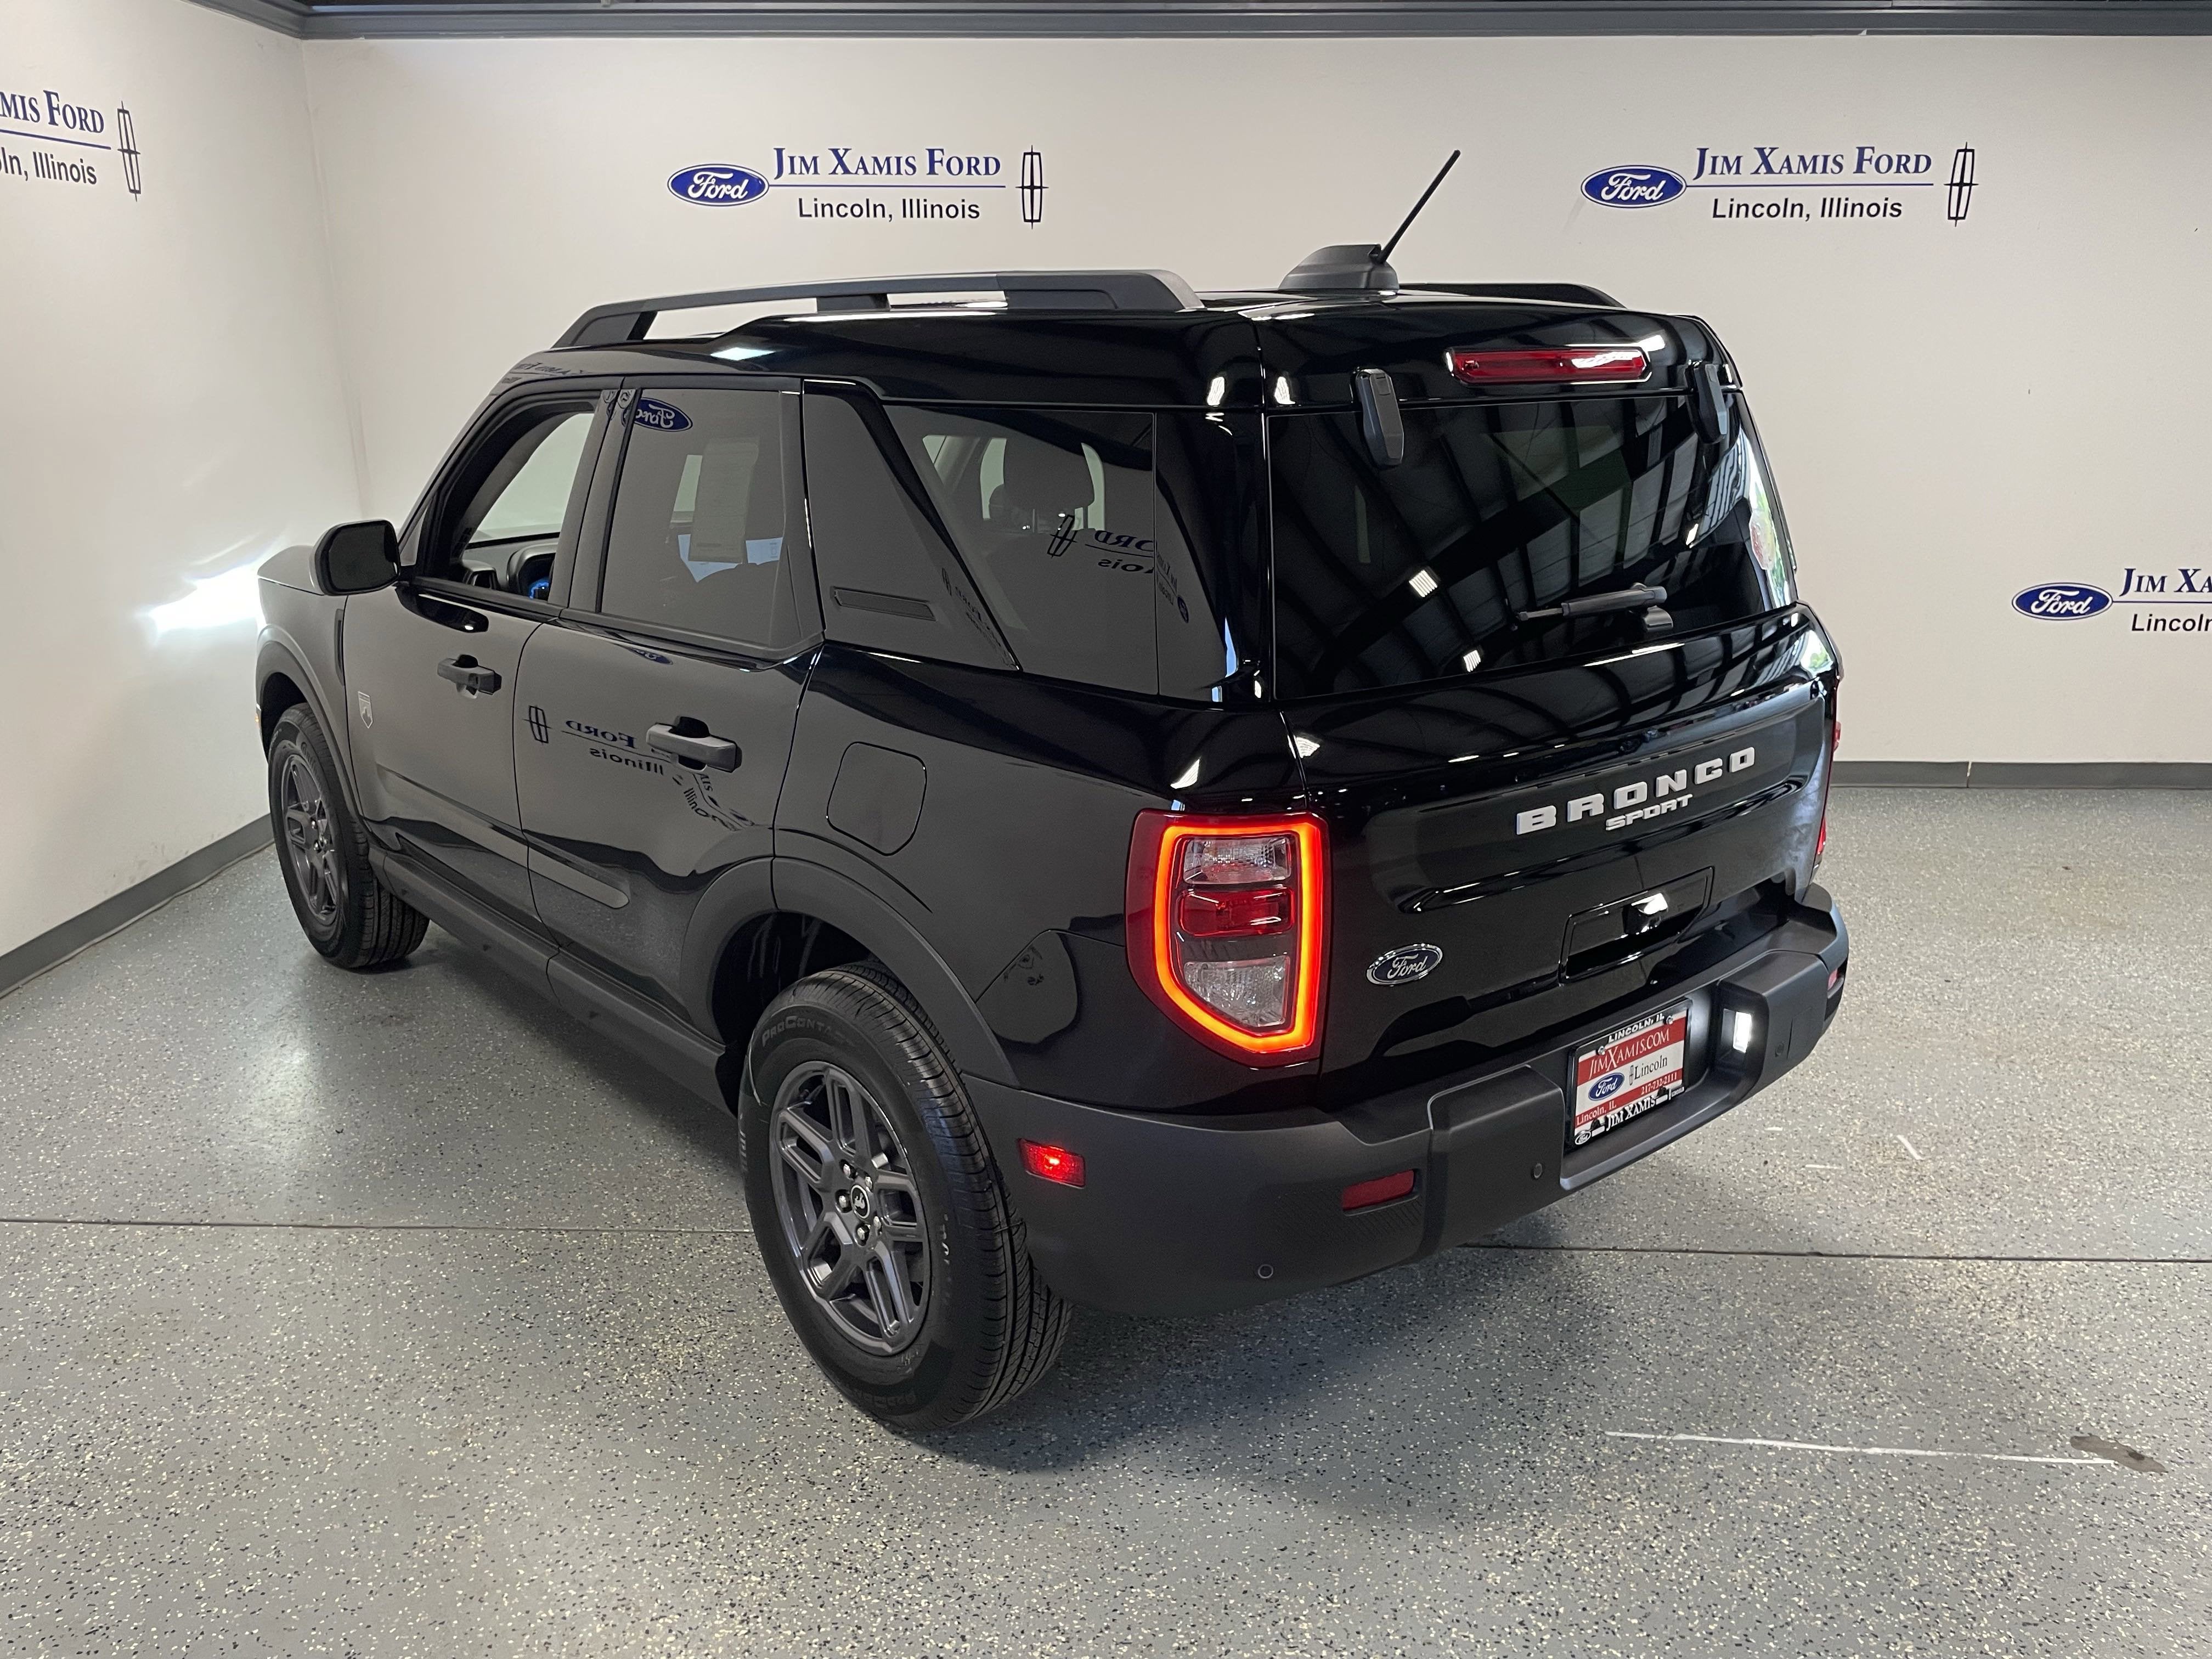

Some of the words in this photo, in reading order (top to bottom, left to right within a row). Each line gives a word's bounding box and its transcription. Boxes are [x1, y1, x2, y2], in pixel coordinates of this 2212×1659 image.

[0, 91, 41, 123] MIS
[43, 90, 104, 133] FORD
[0, 146, 28, 181] ln,
[33, 151, 97, 185] Illinois
[774, 148, 820, 180] JIM
[828, 148, 917, 176] XAMIS
[926, 148, 1001, 176] FORD
[1693, 146, 1743, 180] JIM
[1751, 146, 1844, 176] XAMIS
[1854, 146, 1932, 174] FORD
[687, 172, 748, 201] Ford
[1601, 173, 1664, 202] Ford
[799, 198, 893, 222] Lincoln,
[902, 199, 980, 219] Illinois
[1712, 198, 1811, 222] Lincoln,
[1820, 197, 1902, 218] Illinois
[2119, 568, 2168, 597] JIM
[2030, 589, 2093, 614] Ford
[1516, 747, 1755, 836] BRONCO
[1606, 794, 1693, 831] SPORT
[1387, 953, 1429, 979] Ford
[1608, 1018, 1654, 1043] LINCOLN,
[1656, 1013, 1664, 1022] IL
[1589, 1028, 1670, 1080] JIMXAMIS.COM
[1634, 1054, 1668, 1080] Lincoln
[1641, 1072, 1678, 1095] 217-732-2111
[1606, 1111, 1623, 1131] JIM
[1625, 1095, 1656, 1119] XAMIS
[1609, 1101, 1617, 1111] IL
